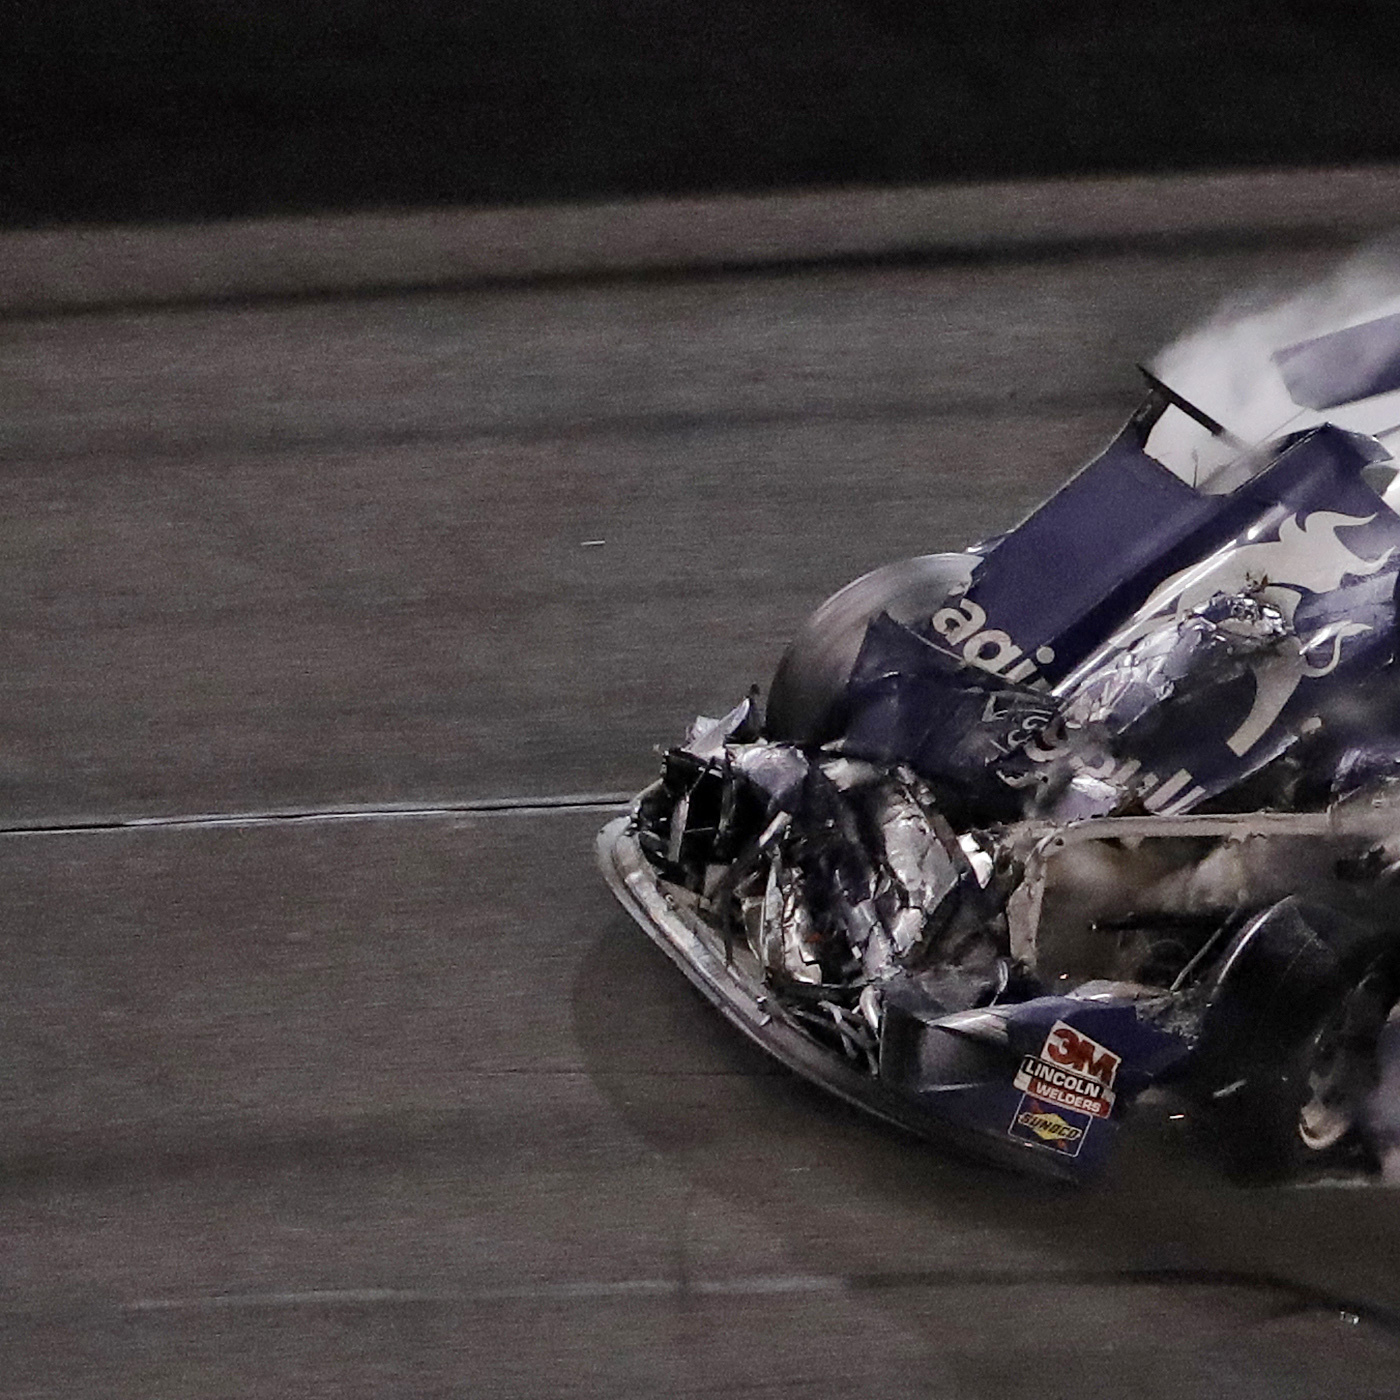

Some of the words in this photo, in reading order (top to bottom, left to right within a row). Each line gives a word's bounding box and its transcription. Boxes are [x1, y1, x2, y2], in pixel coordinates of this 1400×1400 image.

[1048, 1028, 1118, 1086] 3M
[1026, 1060, 1100, 1097] LINCOLN
[1036, 1081, 1102, 1112] WELDERS
[1020, 1114, 1082, 1140] SUNOCO
